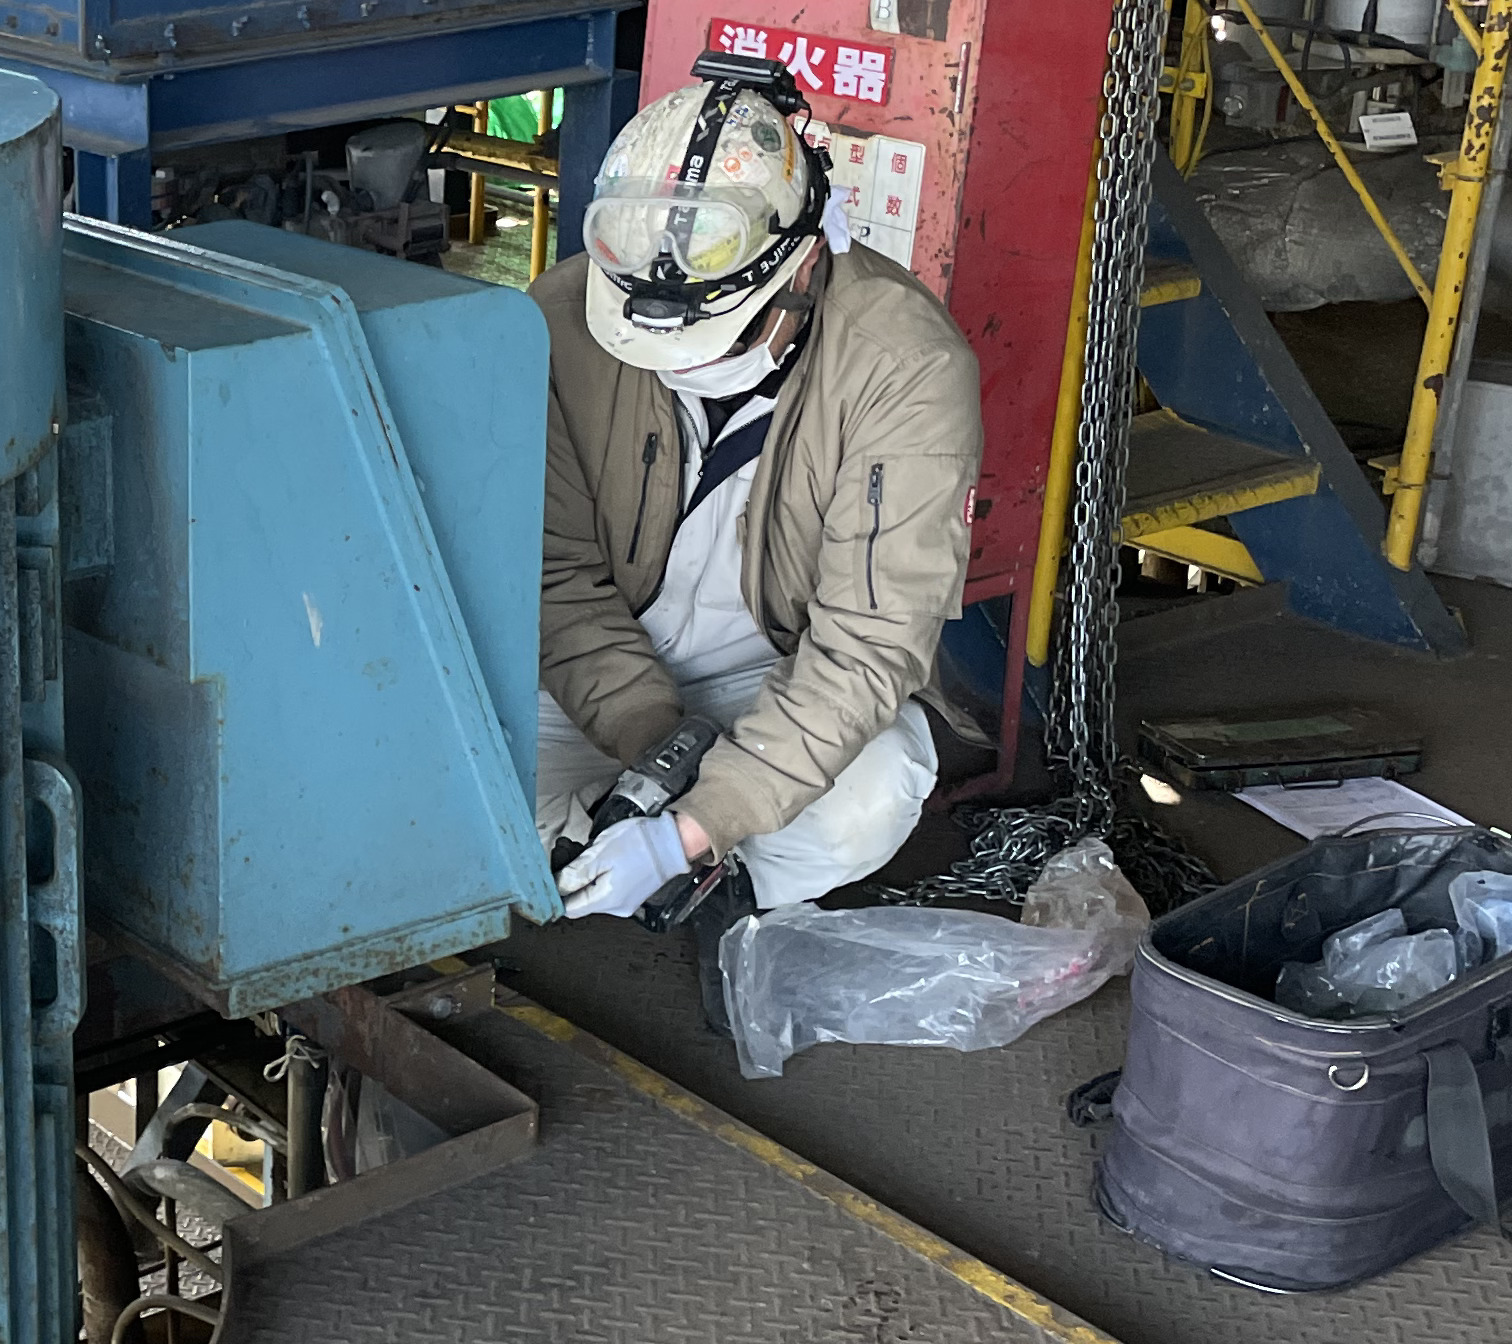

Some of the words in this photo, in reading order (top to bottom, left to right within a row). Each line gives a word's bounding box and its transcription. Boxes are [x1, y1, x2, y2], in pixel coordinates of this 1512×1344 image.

[718, 24, 887, 104] 消火器
[886, 152, 908, 217] 個数
